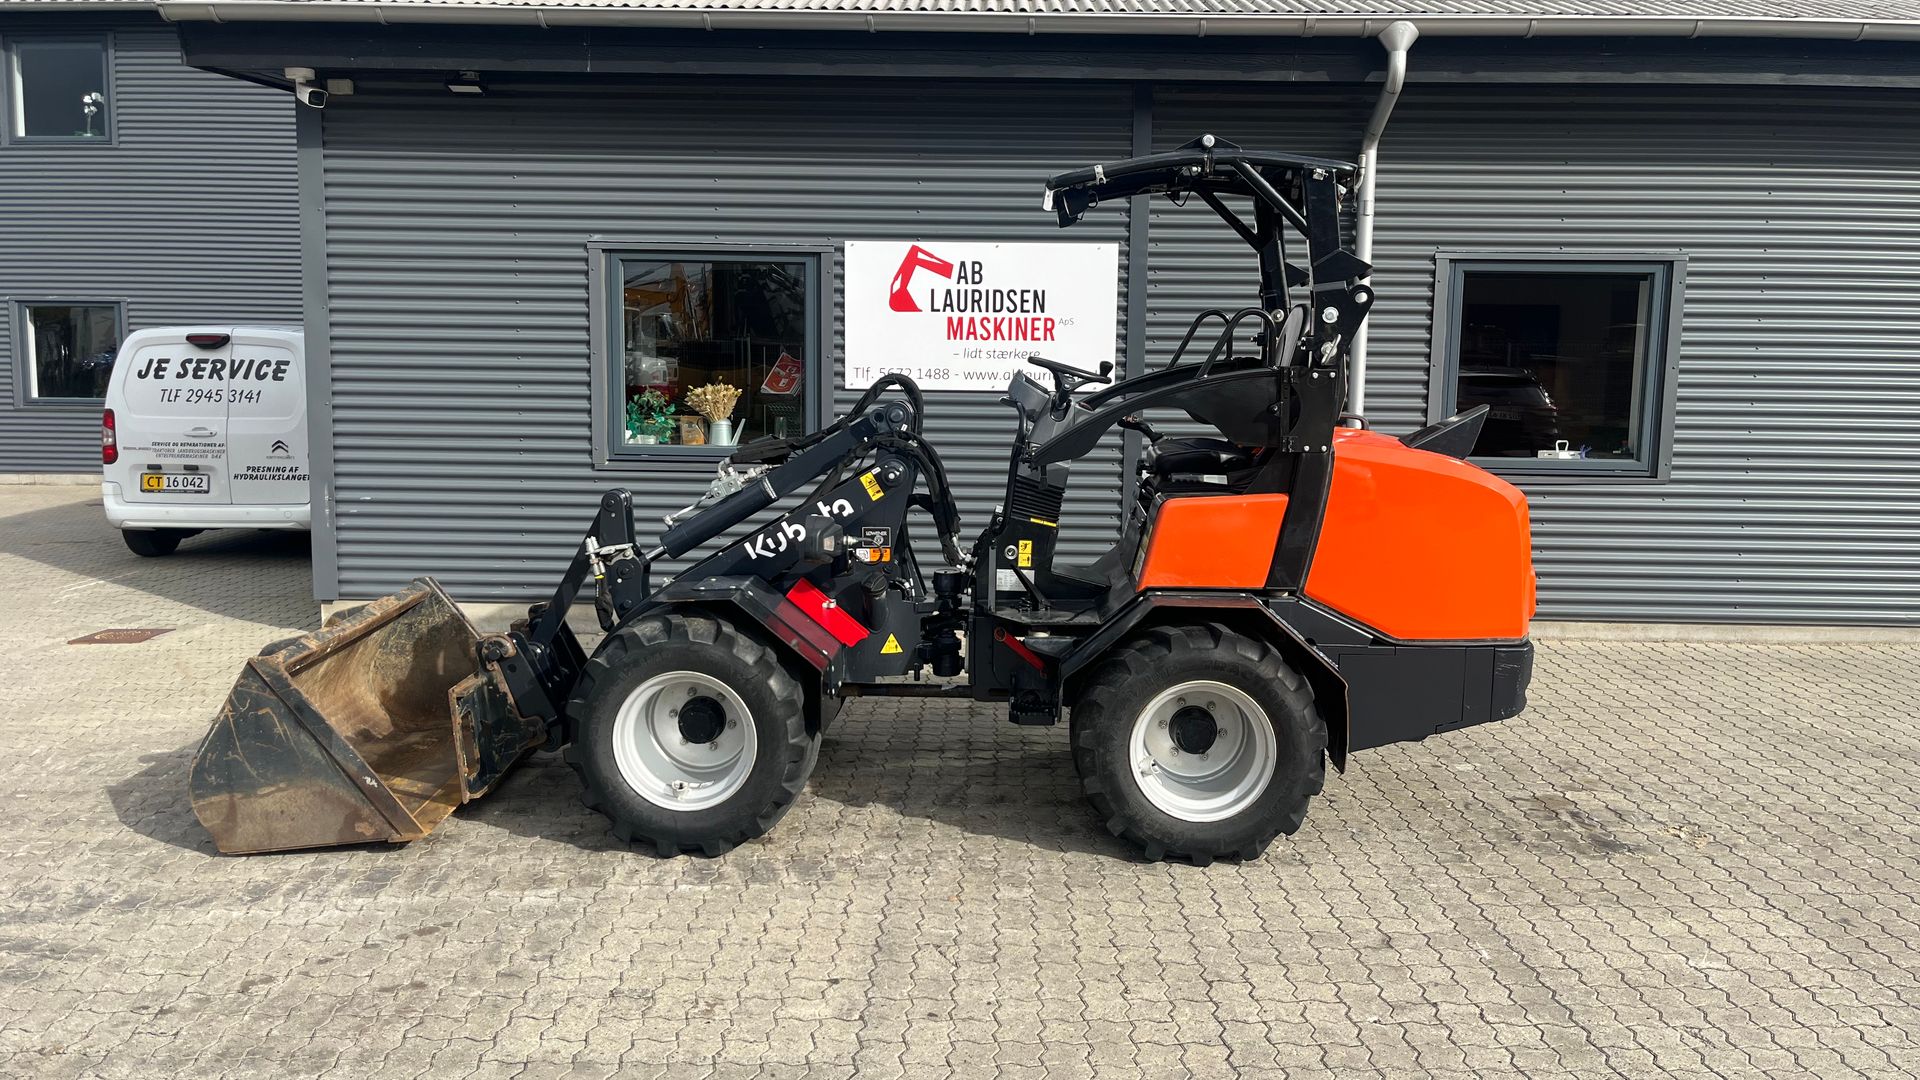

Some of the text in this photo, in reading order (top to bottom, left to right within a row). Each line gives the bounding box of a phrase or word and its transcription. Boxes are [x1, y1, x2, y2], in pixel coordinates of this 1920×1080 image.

[956, 260, 984, 285] AB
[930, 288, 1046, 313] LAURIDSEN
[946, 316, 1075, 341] MASKINER ApS
[963, 347, 983, 359] lidt
[985, 347, 1041, 360] stærkere
[136, 357, 291, 382] JE SERVICE
[853, 366, 874, 382] Tlf.
[916, 367, 950, 380] 1488
[160, 388, 262, 404] TLF 2945 3141
[246, 465, 287, 473] PRESNING
[147, 476, 204, 488] CT 16 042
[743, 498, 855, 560] Kubta
